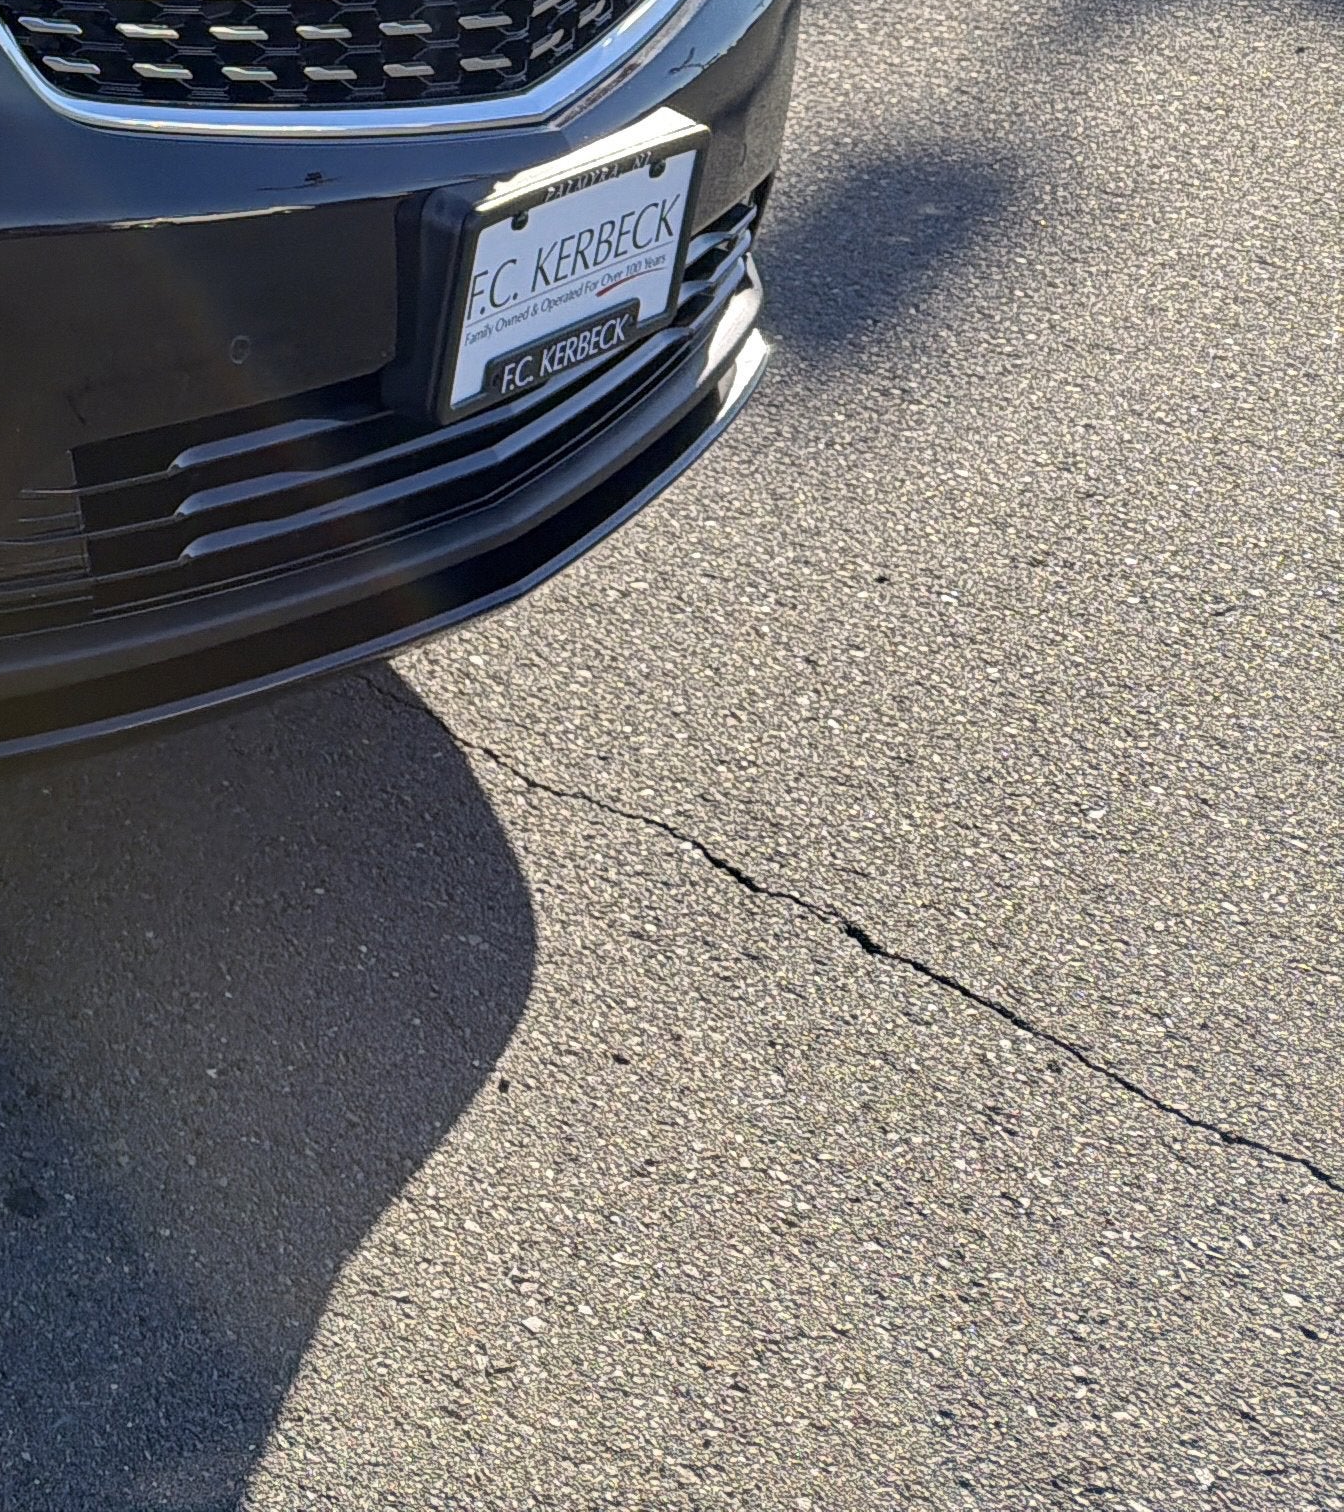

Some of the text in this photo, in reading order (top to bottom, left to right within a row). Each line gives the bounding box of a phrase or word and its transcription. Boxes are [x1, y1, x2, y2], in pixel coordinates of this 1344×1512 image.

[463, 322, 493, 347] Family
[495, 304, 530, 333] Owned
[540, 283, 585, 314] Operated
[583, 278, 599, 296] For
[600, 269, 624, 288] Over
[625, 260, 643, 277] 100
[643, 254, 667, 270] Years
[466, 193, 681, 321] F.C. KERBECK
[500, 313, 630, 395] F.C. KERBECK
